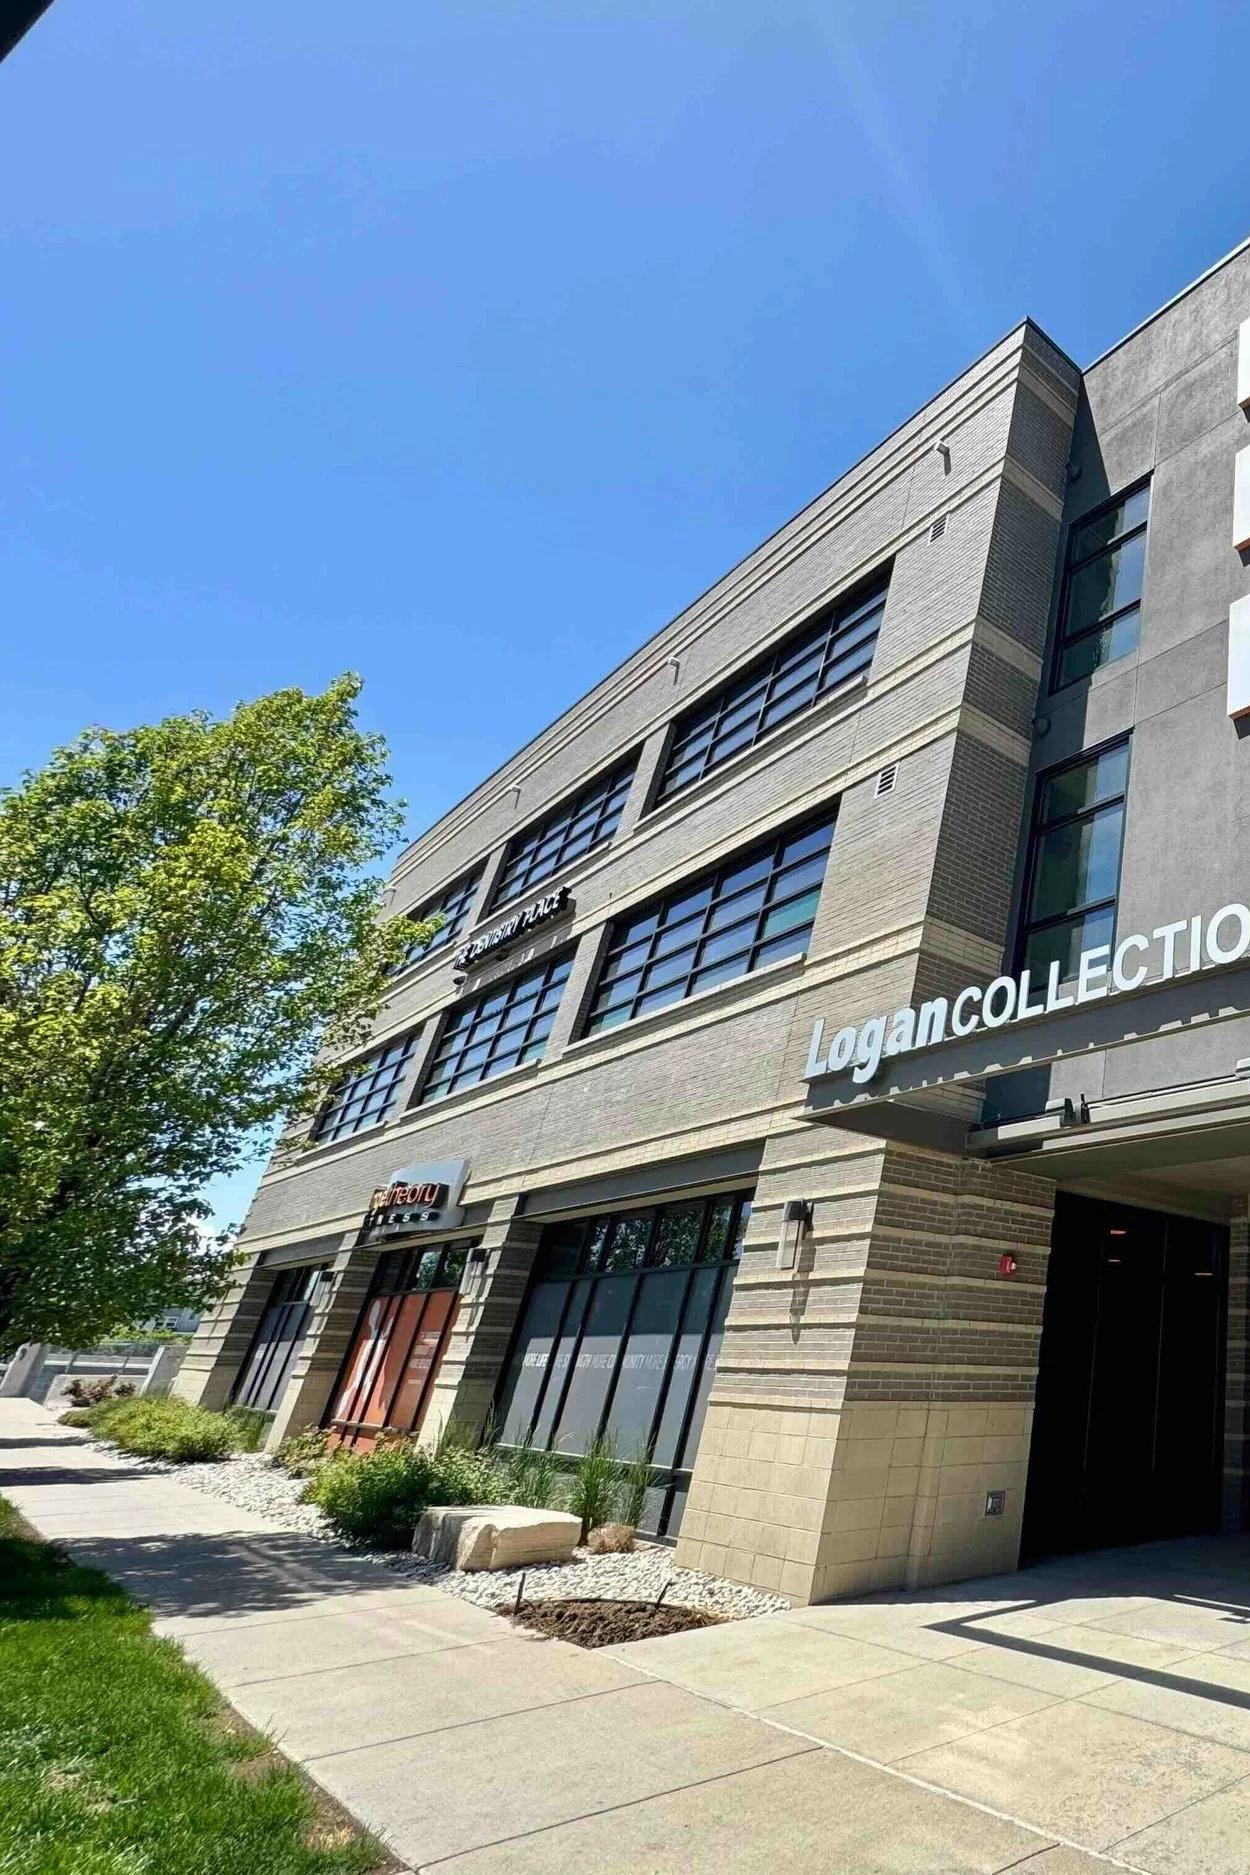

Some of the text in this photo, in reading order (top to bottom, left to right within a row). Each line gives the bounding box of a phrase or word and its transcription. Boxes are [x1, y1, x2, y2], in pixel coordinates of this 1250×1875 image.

[521, 887, 564, 928] PLACE
[371, 1183, 440, 1216] getheory
[368, 1210, 431, 1227] TNESS
